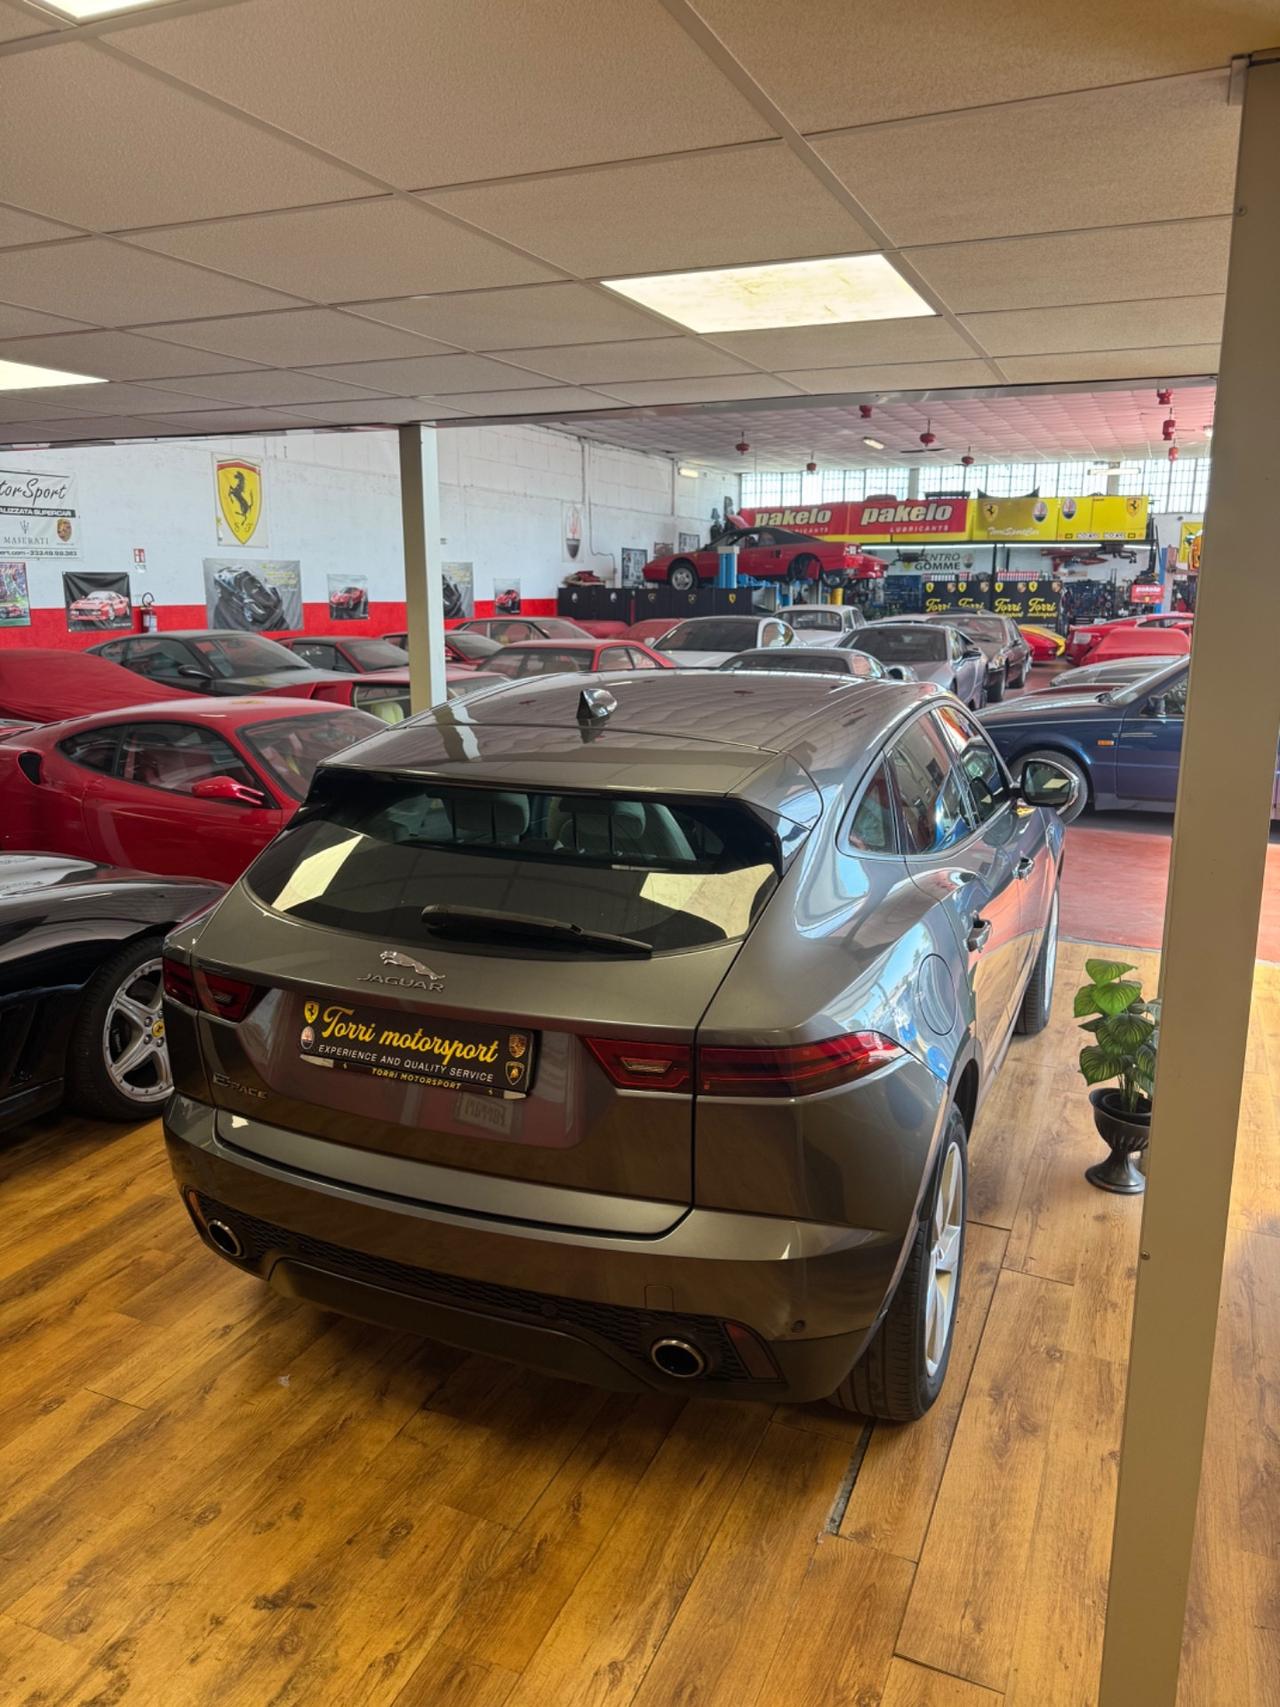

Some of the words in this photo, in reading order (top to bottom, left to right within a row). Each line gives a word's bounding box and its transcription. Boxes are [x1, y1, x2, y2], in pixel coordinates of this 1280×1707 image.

[33, 509, 72, 517] SUPERCAR
[755, 507, 832, 527] pakelo
[861, 503, 953, 526] pakelo
[889, 525, 949, 533] LUBRICANTS
[3, 536, 49, 545] MASERATI
[925, 552, 961, 562] ENTRO
[914, 561, 961, 571] GOMME
[994, 597, 1022, 613] Torri
[1028, 597, 1057, 613] Torri
[357, 972, 445, 993] JAGUAR
[321, 1005, 377, 1042] Torri
[379, 1028, 500, 1066] motorsport
[318, 1044, 378, 1063] EXPERIENCE
[380, 1056, 402, 1067] AND
[404, 1059, 448, 1077] QUALITY
[449, 1067, 494, 1083] SERVICE
[371, 1067, 399, 1080] TORRI
[400, 1072, 462, 1090] MOTORSPORT
